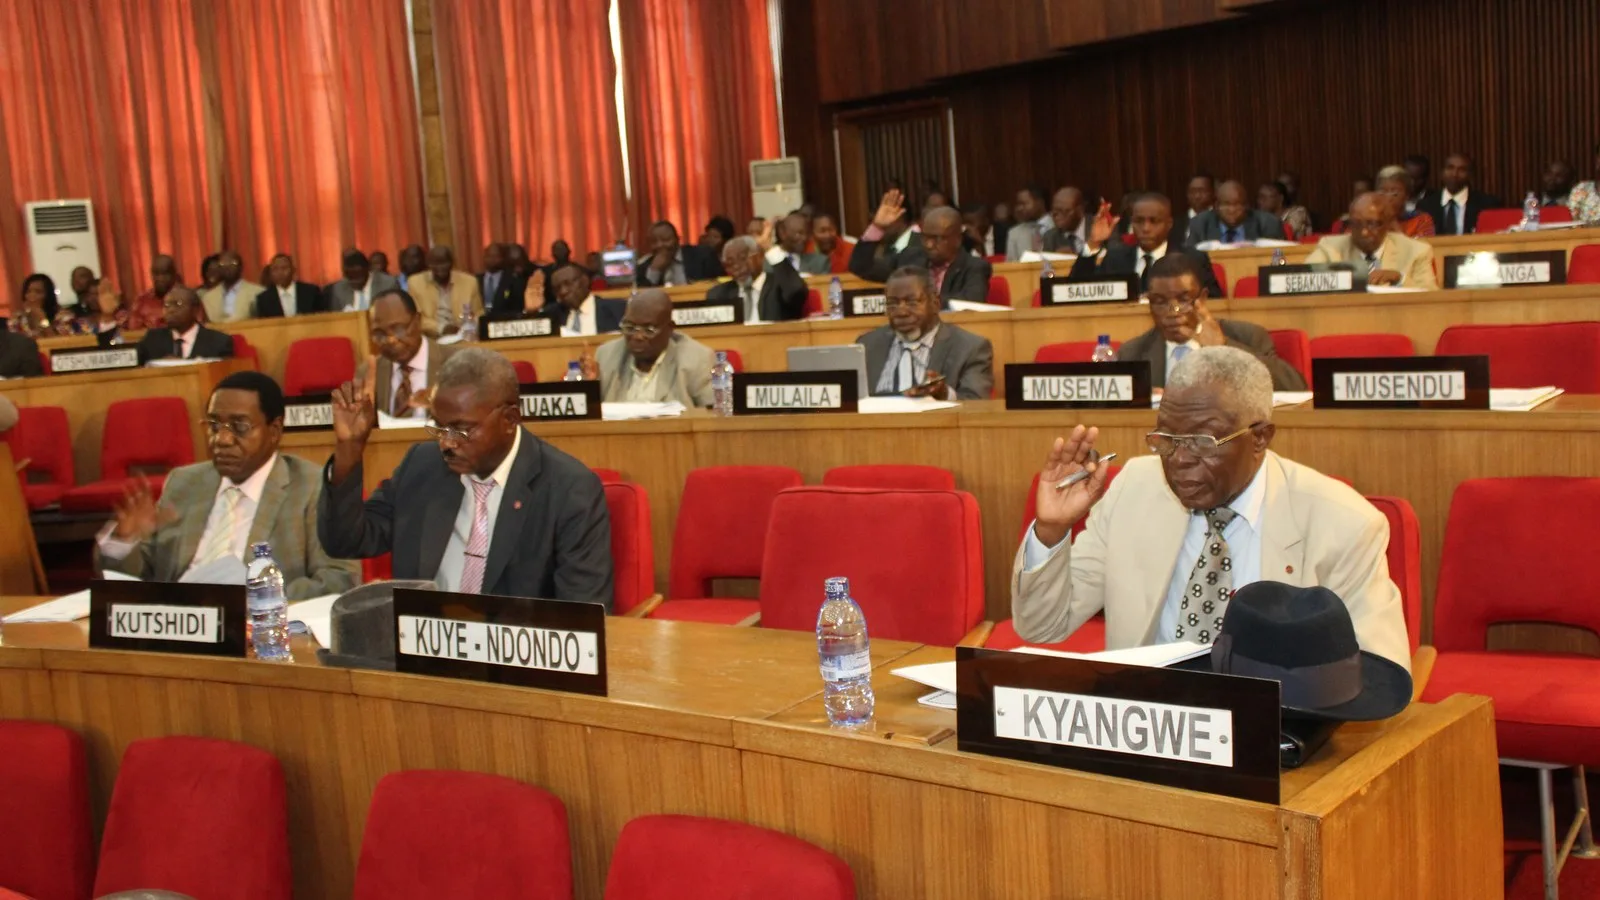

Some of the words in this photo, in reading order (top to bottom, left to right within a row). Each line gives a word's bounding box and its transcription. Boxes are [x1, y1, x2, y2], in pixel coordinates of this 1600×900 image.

[1068, 284, 1114, 299] SALUMU
[1285, 272, 1339, 292] SEBAKUNZI
[862, 297, 887, 314] RUH
[755, 386, 832, 407] MULAILA
[1032, 377, 1121, 400] MUSEMA
[1345, 374, 1454, 400] MUSENDU
[289, 406, 333, 425] M'PAM
[116, 611, 206, 636] KUTSHIDI
[415, 618, 468, 660] KUYE
[486, 625, 580, 671] NDONDO
[1023, 694, 1212, 760] KYANGWE
